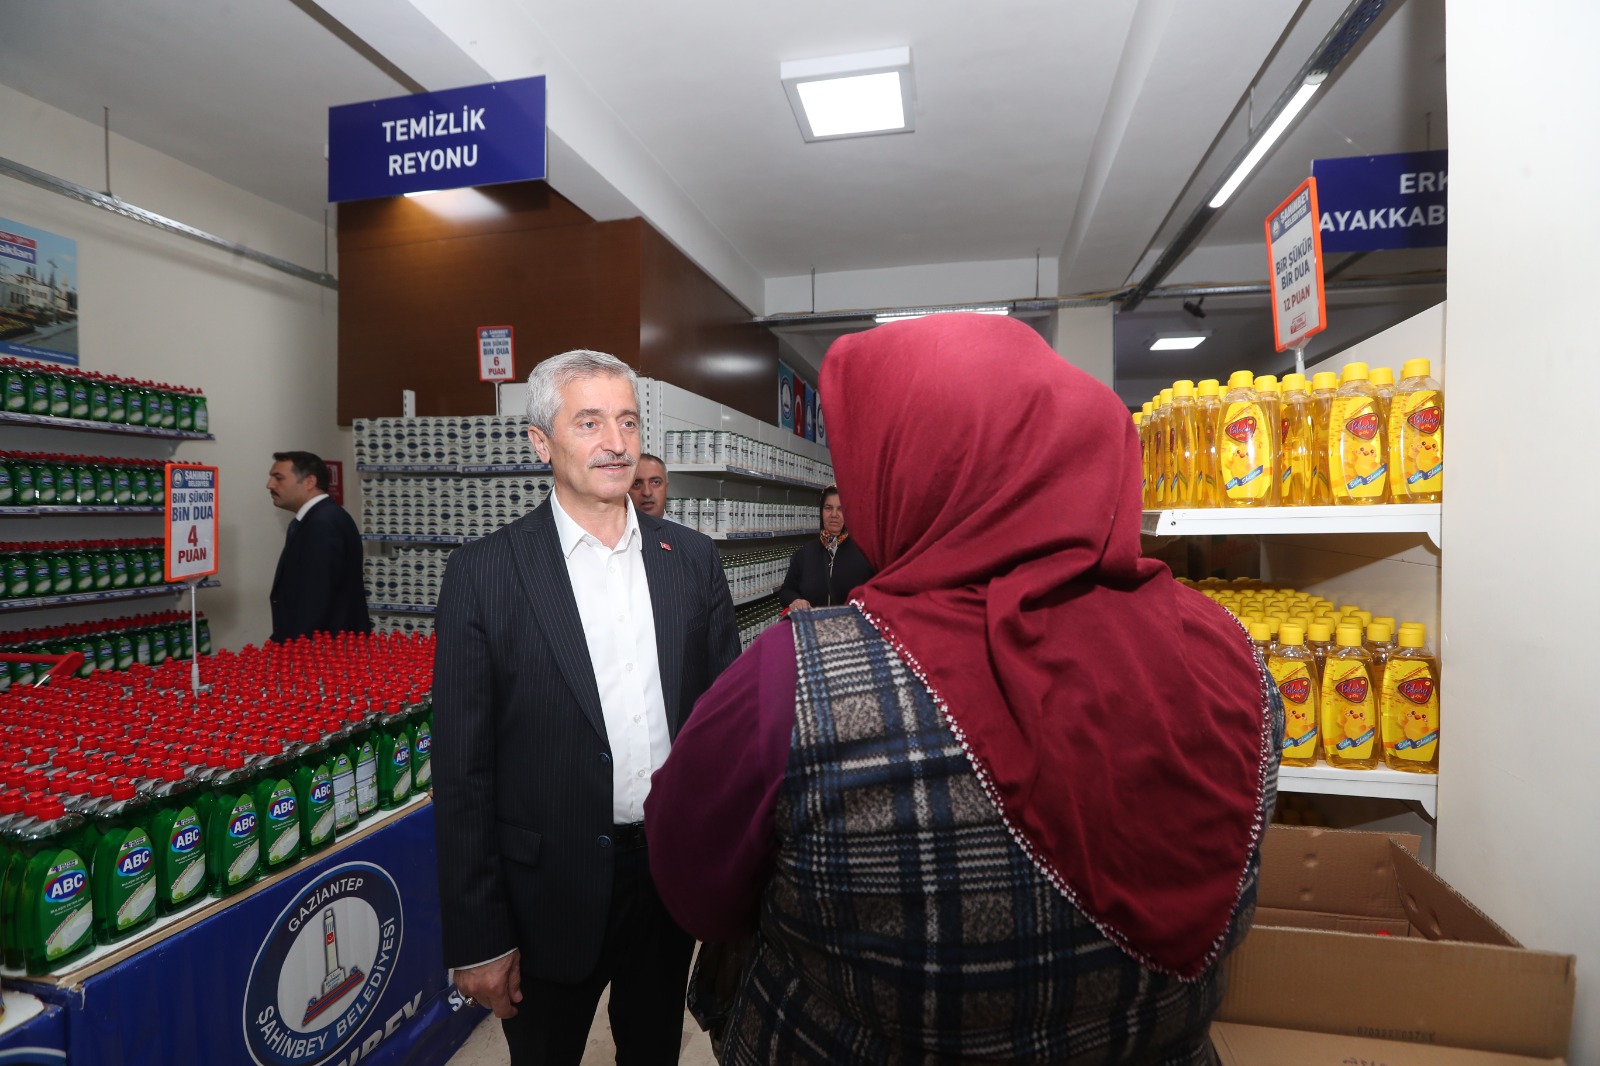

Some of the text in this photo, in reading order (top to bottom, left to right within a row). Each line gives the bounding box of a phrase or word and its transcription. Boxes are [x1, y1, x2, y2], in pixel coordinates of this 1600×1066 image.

[382, 105, 486, 142] TEMİZLİK
[388, 144, 478, 176] REYONU
[1294, 260, 1310, 283] DUA
[1283, 284, 1311, 312] 12 PUAN
[493, 356, 500, 366] 6
[488, 368, 506, 376] PUAN
[188, 490, 214, 506] ŞÜKÜR
[193, 506, 213, 520] DUA
[187, 525, 198, 547] 4
[178, 547, 207, 564] PUAN
[314, 784, 331, 800] ABC
[273, 799, 294, 817] ABC
[233, 815, 255, 834] ABC
[176, 829, 199, 849] ABC
[122, 850, 150, 873] ABC
[51, 873, 83, 899] ABC
[288, 878, 364, 933] GAZİANTEP
[255, 917, 395, 1059] ŞAHİNBEY BELEDİYESİ
